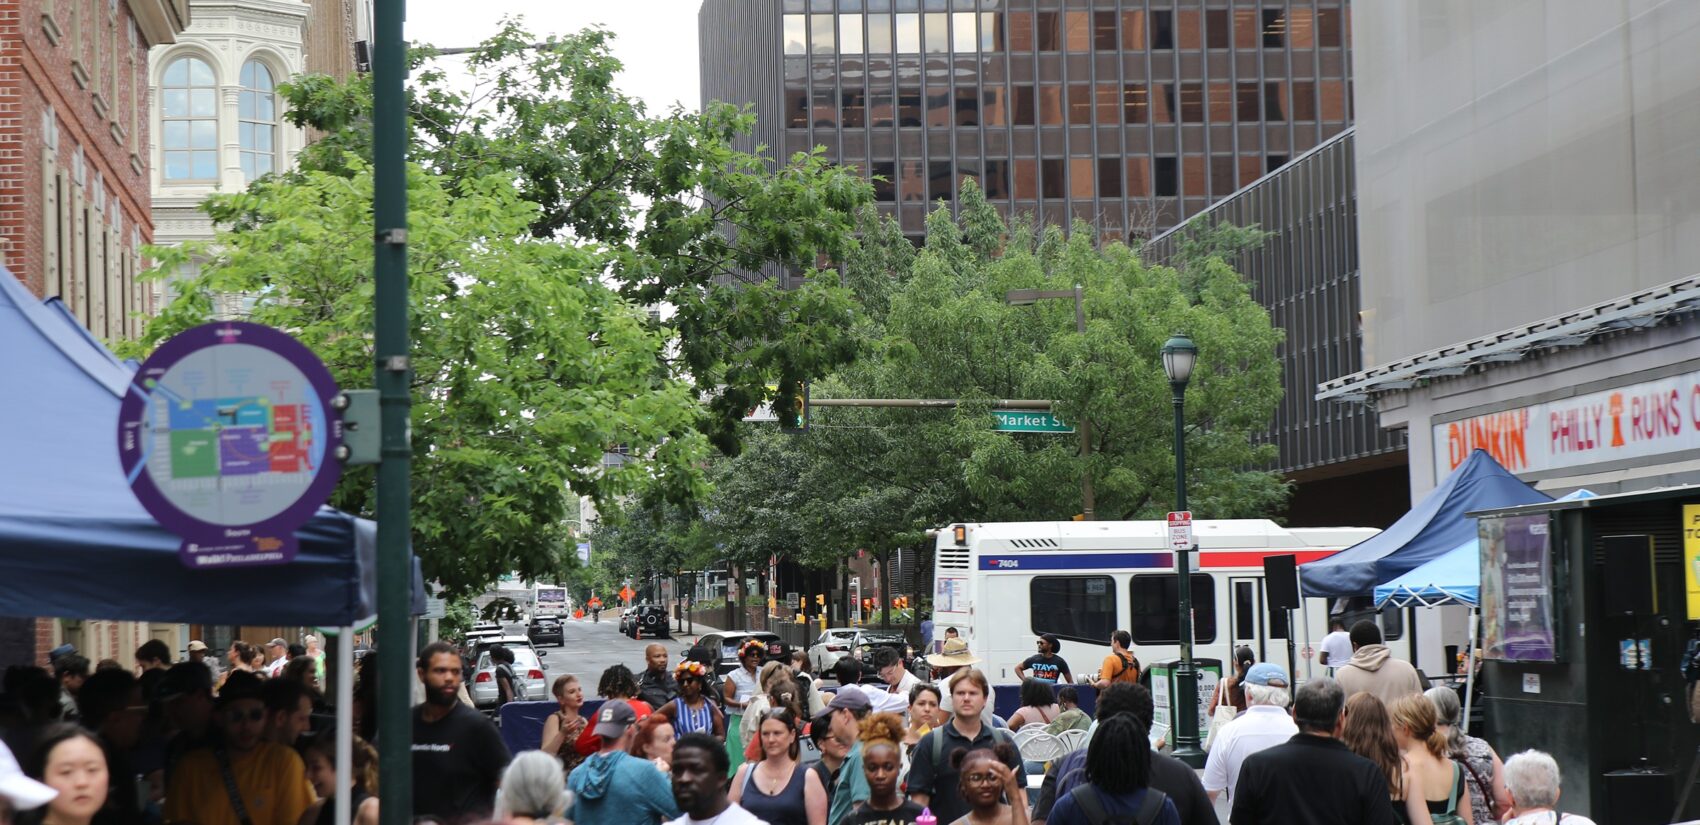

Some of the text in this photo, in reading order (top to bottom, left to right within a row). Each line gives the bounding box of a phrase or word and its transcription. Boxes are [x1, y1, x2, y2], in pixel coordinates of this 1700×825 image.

[996, 414, 1046, 426] Market
[1449, 407, 1528, 470] DUNKIN'
[1551, 404, 1603, 455] PHILLY
[1631, 389, 1681, 441] RUNS
[998, 559, 1018, 568] 7404
[1032, 663, 1051, 671] STAY
[601, 708, 613, 722] S
